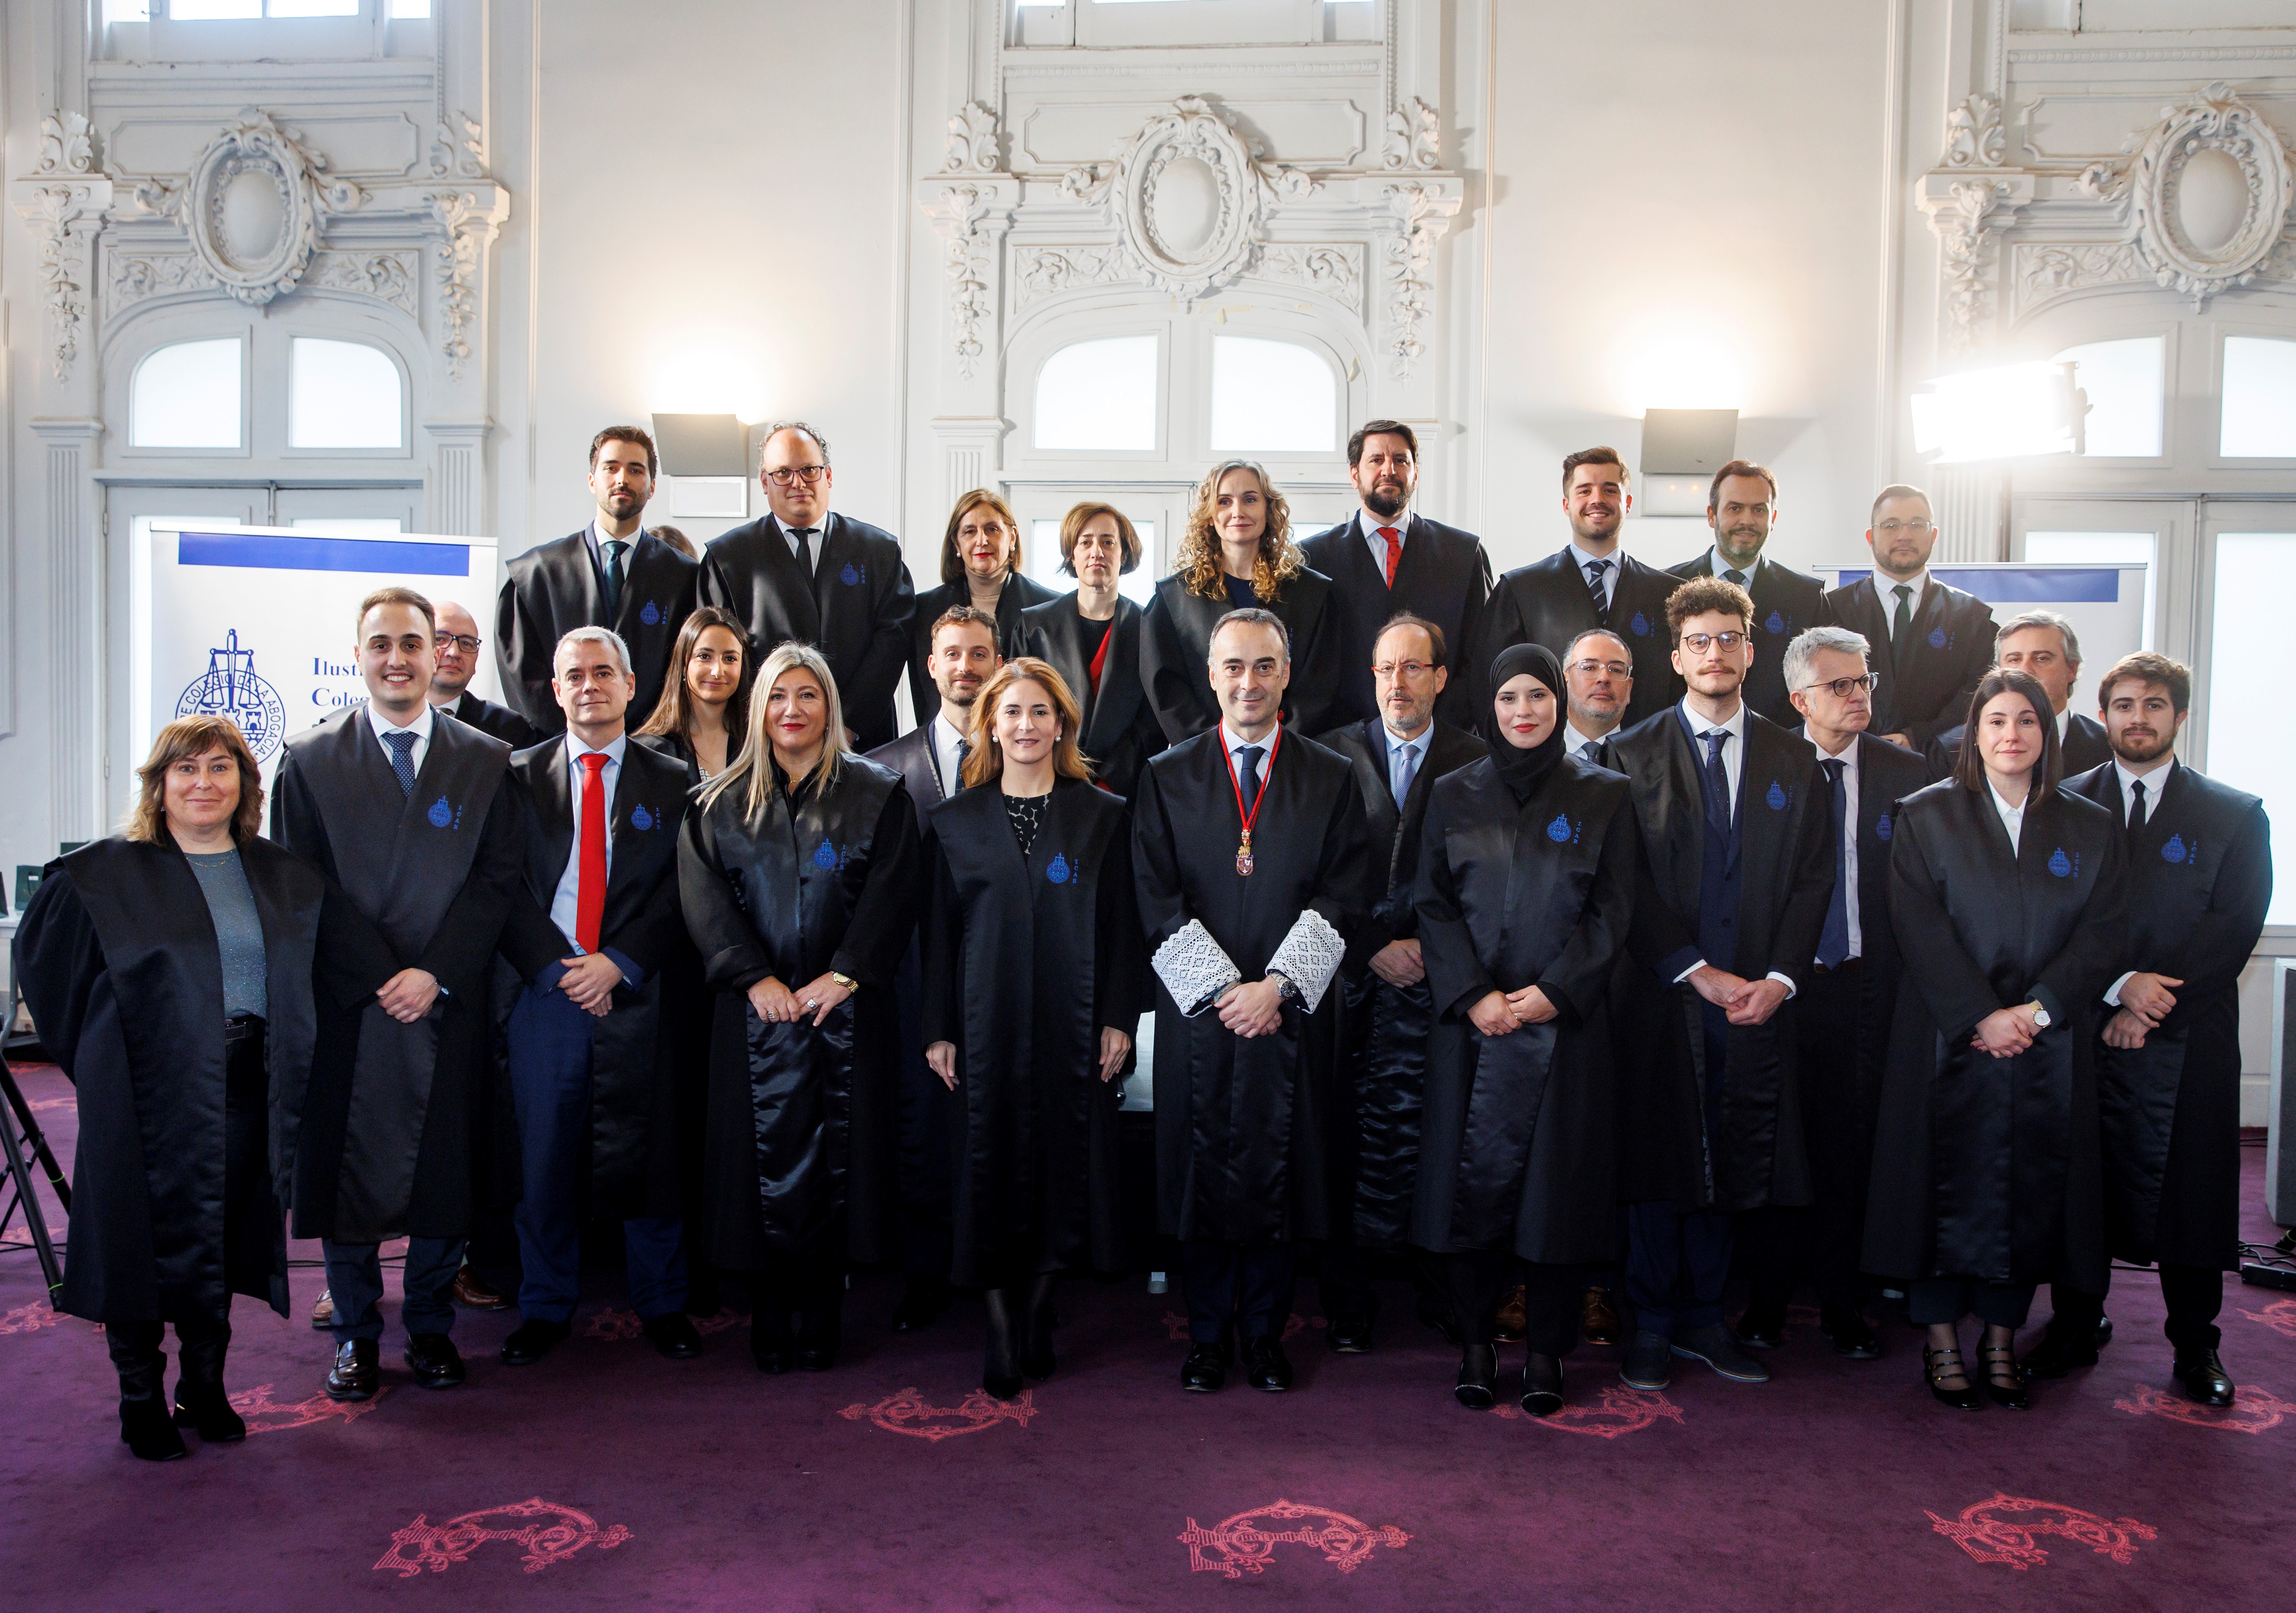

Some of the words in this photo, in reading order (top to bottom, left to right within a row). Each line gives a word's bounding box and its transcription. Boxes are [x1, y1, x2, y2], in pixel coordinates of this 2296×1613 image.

[238, 675, 254, 687] DE
[254, 683, 269, 699] LA
[454, 805, 463, 830] ICAR
[1573, 821, 1582, 844] ICAR
